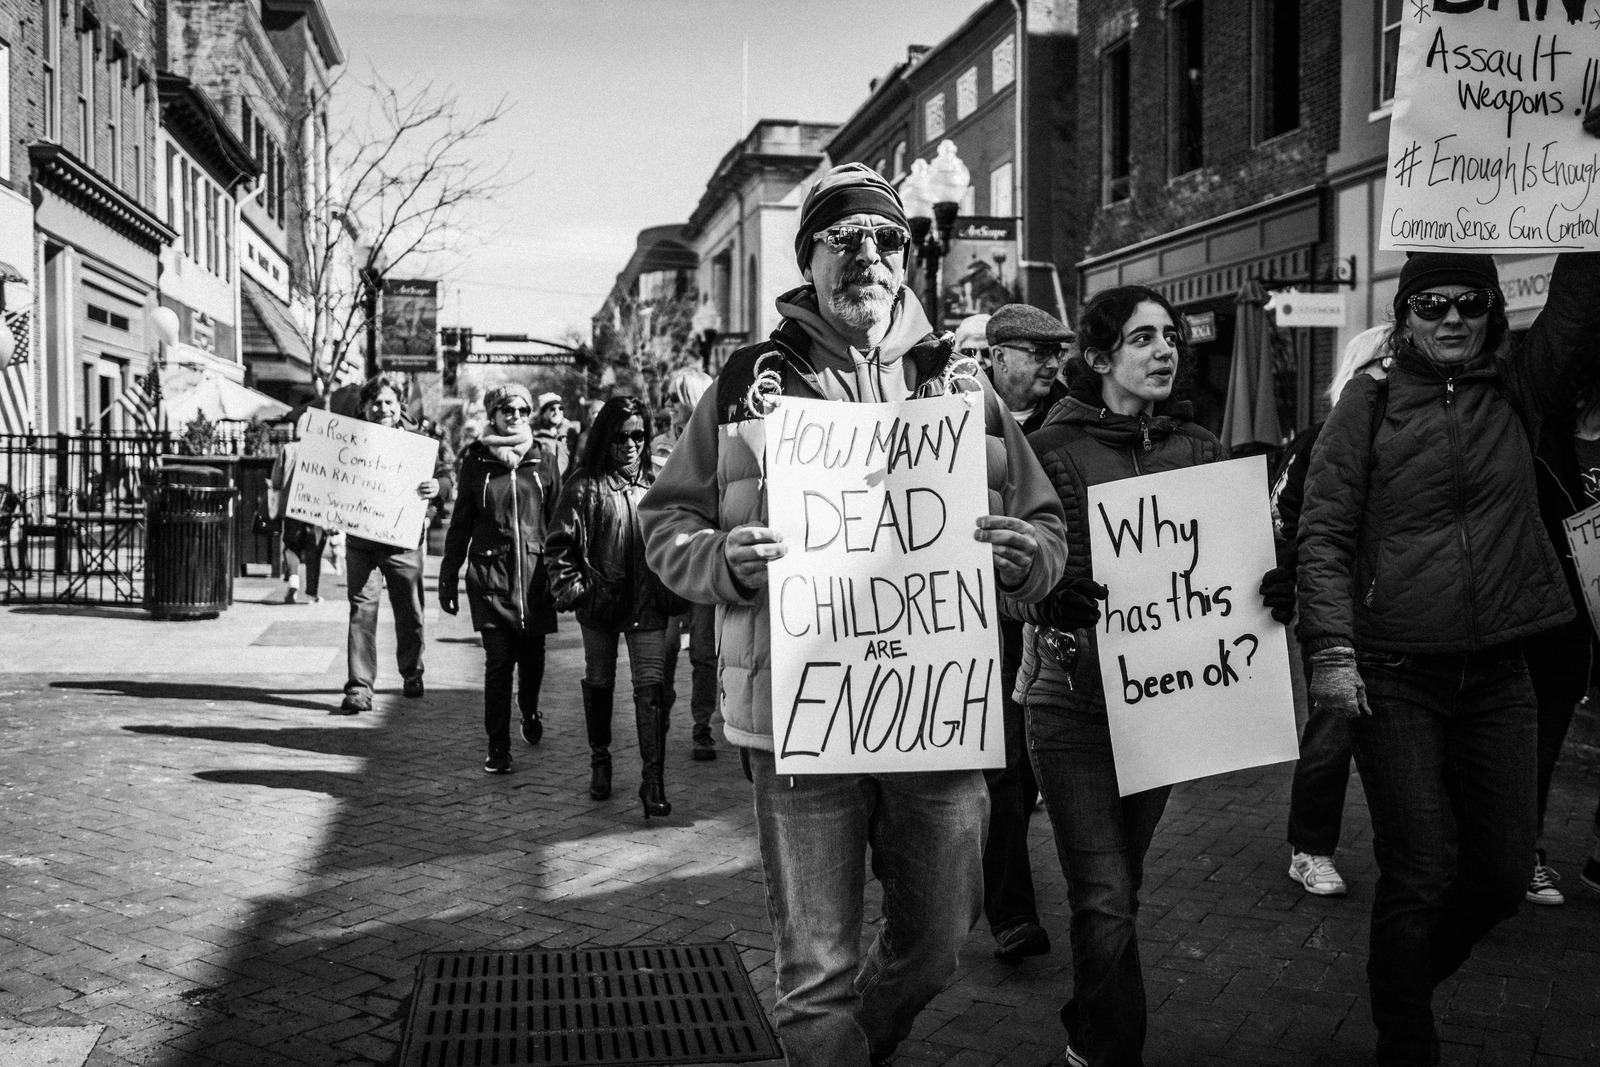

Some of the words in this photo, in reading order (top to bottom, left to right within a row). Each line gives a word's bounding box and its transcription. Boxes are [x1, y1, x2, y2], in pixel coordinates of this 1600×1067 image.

[1426, 26, 1572, 82] Assault
[1508, 205, 1543, 240] Gun
[1547, 204, 1599, 243] Control
[301, 459, 326, 478] NRA
[775, 409, 858, 469] HOW
[865, 410, 970, 474] MANY
[803, 487, 946, 555] DEAD
[1097, 494, 1199, 578] Why
[780, 568, 988, 642] CHILDREN
[1103, 584, 1162, 634] has
[1166, 570, 1232, 622] this
[864, 640, 908, 661] ARE
[1117, 654, 1194, 705] been
[1203, 633, 1259, 687] ok?
[780, 658, 994, 759] ENOUGH
